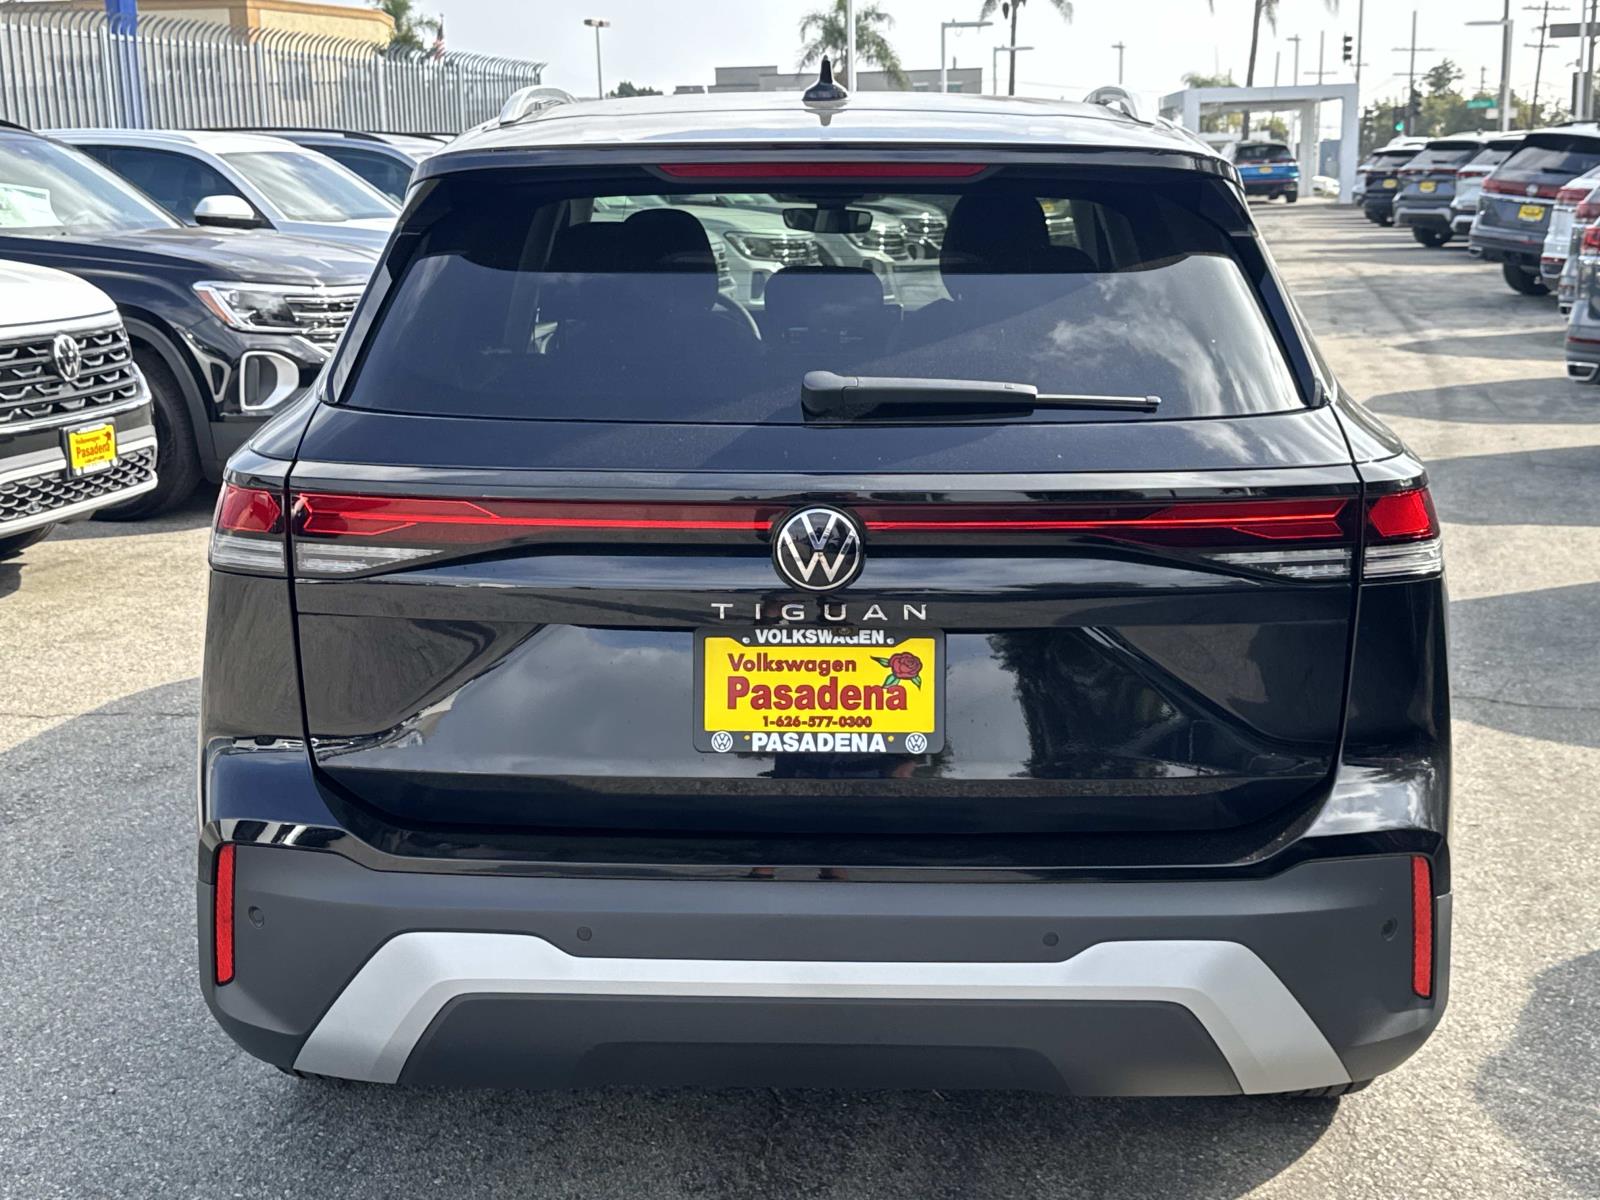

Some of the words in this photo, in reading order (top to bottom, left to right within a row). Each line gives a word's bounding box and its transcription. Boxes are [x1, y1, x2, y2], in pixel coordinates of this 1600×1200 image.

[777, 508, 860, 590] VW
[710, 603, 928, 621] TIGUAN
[727, 652, 857, 676] Volkswagen
[727, 676, 908, 711] Pasadena
[761, 715, 873, 728] 1-626-577-0300
[751, 732, 887, 753] PASADENA
